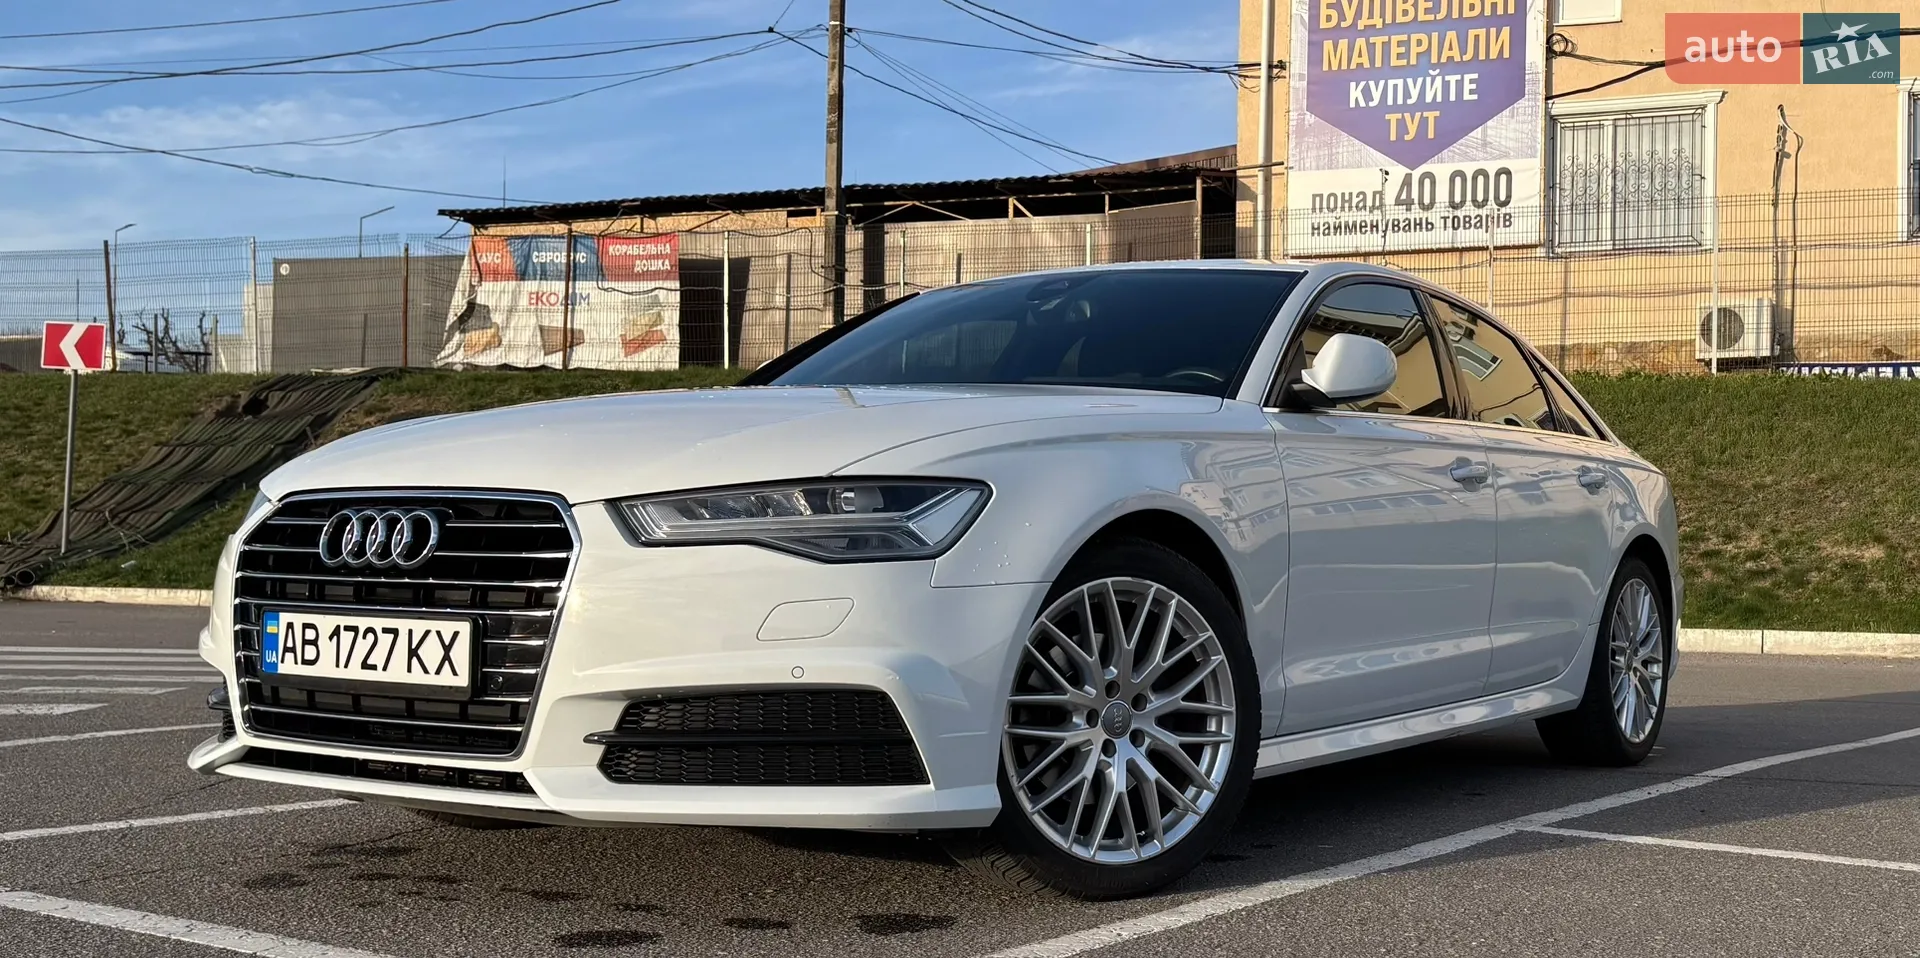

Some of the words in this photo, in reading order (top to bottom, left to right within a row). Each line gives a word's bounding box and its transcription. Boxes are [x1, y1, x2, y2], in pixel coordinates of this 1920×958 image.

[1322, 26, 1511, 71] МАТЕРІАЛИ
[1349, 69, 1479, 108] КУПУЙТЕ
[1385, 111, 1440, 141] ТУТ
[1311, 190, 1385, 215] понад
[1394, 172, 1436, 212] 40
[1449, 167, 1513, 210] 000
[1311, 214, 1435, 238] найменувань
[608, 243, 671, 256] КОРАБЕЛЬНА
[634, 258, 671, 273] ДОШКА
[265, 650, 278, 664] UA
[280, 622, 320, 666] AB
[328, 624, 400, 672] 1727
[407, 628, 460, 676] KX
